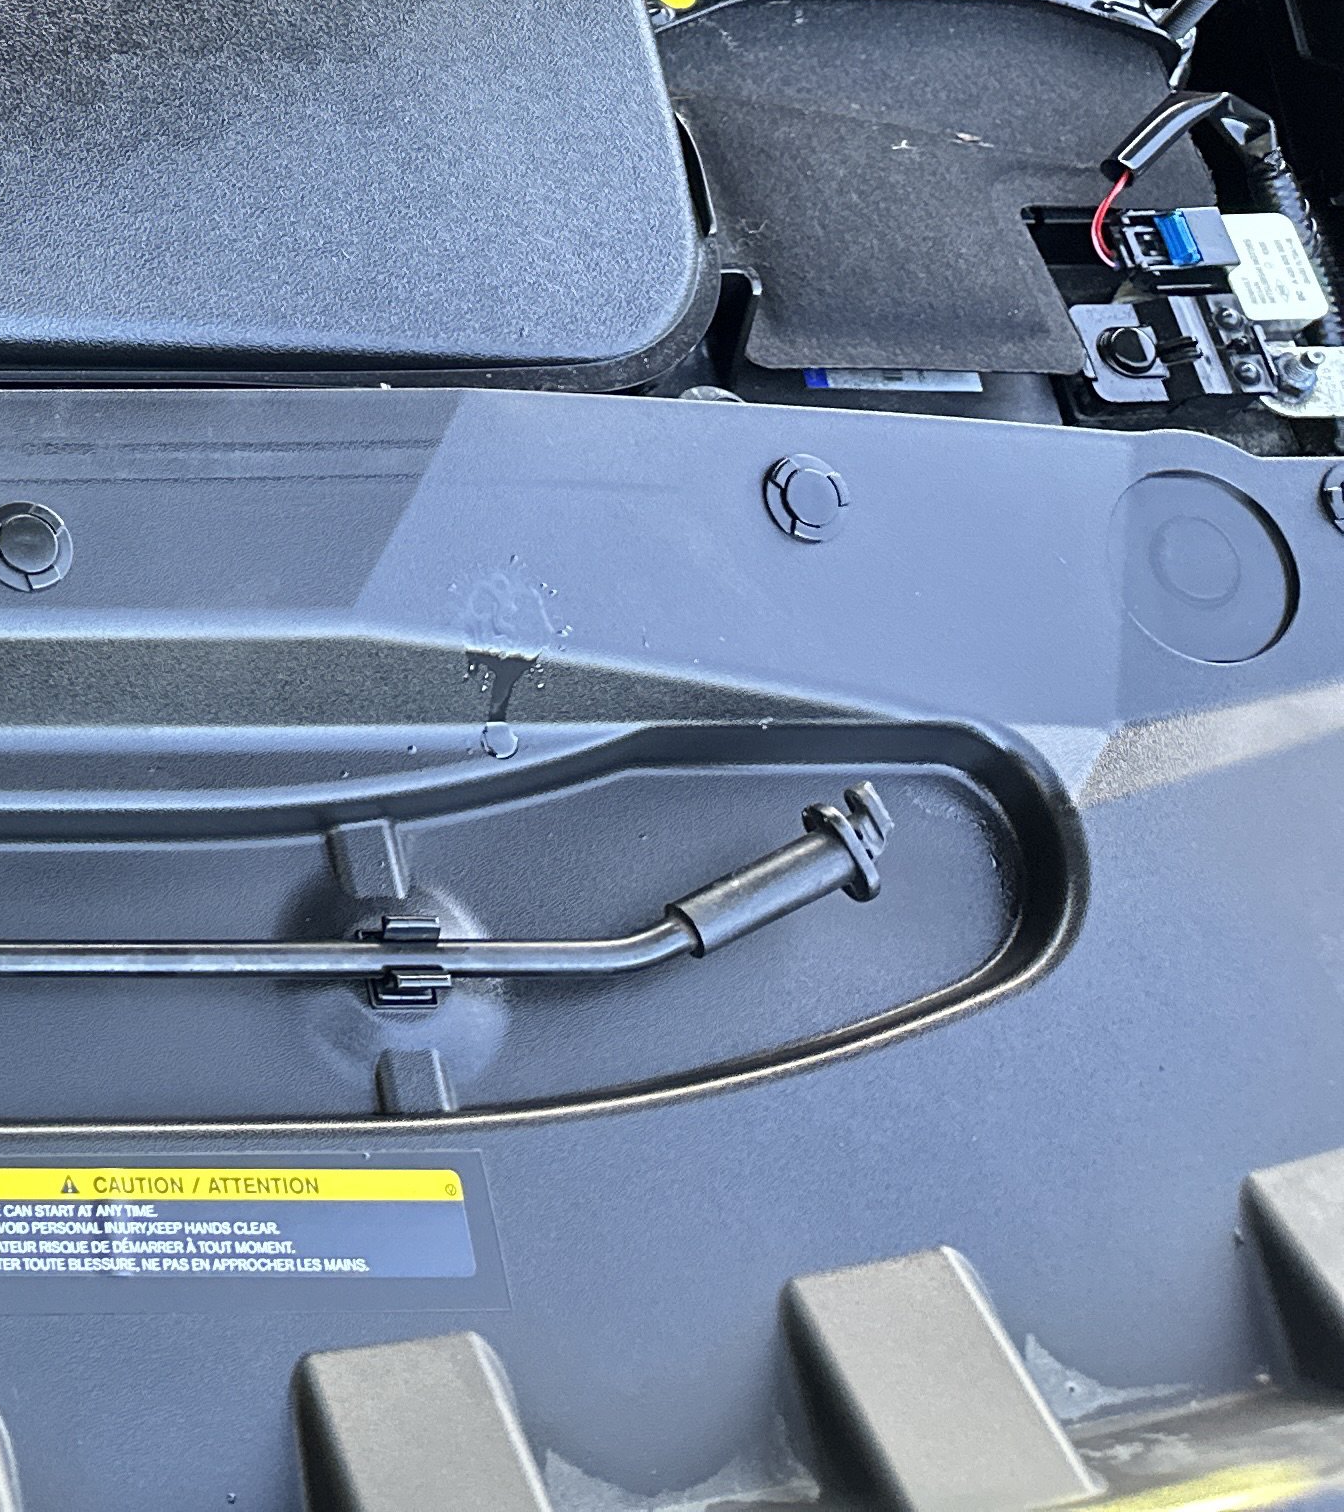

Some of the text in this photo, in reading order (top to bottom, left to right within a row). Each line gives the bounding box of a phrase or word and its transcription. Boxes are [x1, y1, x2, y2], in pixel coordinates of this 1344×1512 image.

[93, 1176, 320, 1194] CAUTION / ATTENTION
[3, 1204, 33, 1218] CAN
[34, 1204, 75, 1218] START
[77, 1204, 93, 1218] AT
[96, 1204, 123, 1218] ANY
[125, 1204, 158, 1218] TIME.
[31, 1221, 103, 1235] PERSONAL
[184, 1221, 232, 1235] HANDS
[233, 1221, 281, 1235] CLEAR.
[39, 1240, 89, 1254] RISQUE
[91, 1240, 111, 1254] DE
[112, 1237, 184, 1254] DÉMARRER
[186, 1237, 197, 1254] À
[198, 1240, 233, 1254] TOUT
[235, 1240, 296, 1254] MOMENT.
[22, 1258, 66, 1271] TOUTE
[67, 1258, 140, 1273] BLESSURE,
[142, 1258, 161, 1271] NE
[162, 1258, 189, 1272] PAS
[191, 1258, 210, 1272] EN
[212, 1258, 295, 1272] APPROCHER
[296, 1258, 322, 1272] LES
[323, 1258, 370, 1272] MAINS.
